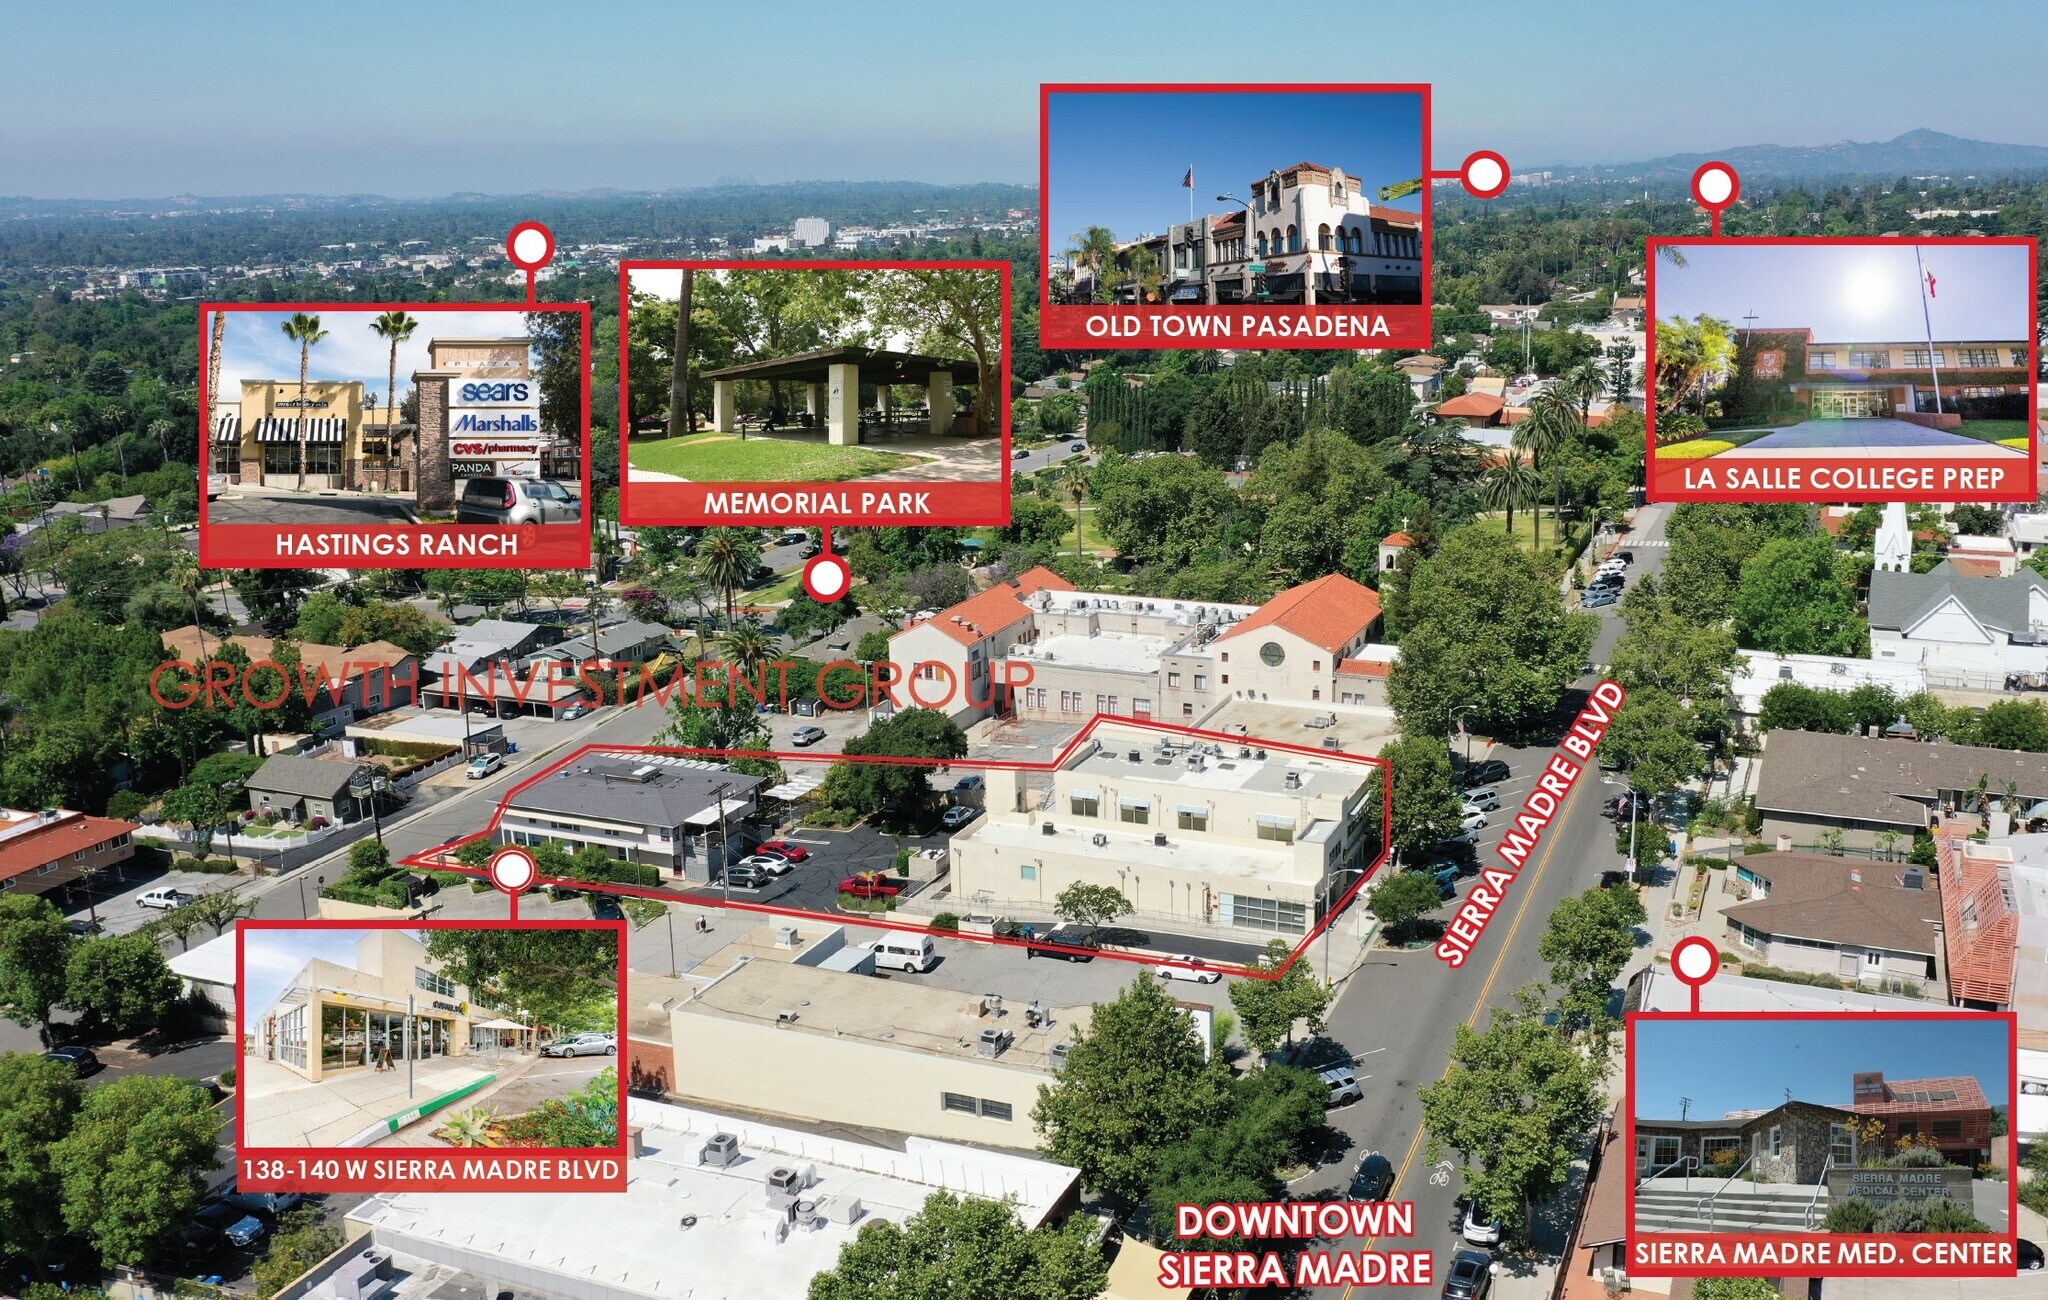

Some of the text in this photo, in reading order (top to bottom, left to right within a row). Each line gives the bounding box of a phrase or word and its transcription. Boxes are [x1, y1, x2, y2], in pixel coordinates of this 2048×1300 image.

[462, 383, 529, 402] sears
[454, 414, 538, 432] Marshalls
[453, 442, 539, 456] CVS/pharmacy
[451, 463, 492, 473] PANDA
[1852, 1173, 1942, 1184] SIERRA MADRE
[1847, 1186, 1950, 1197] MEDICAL CENTER
